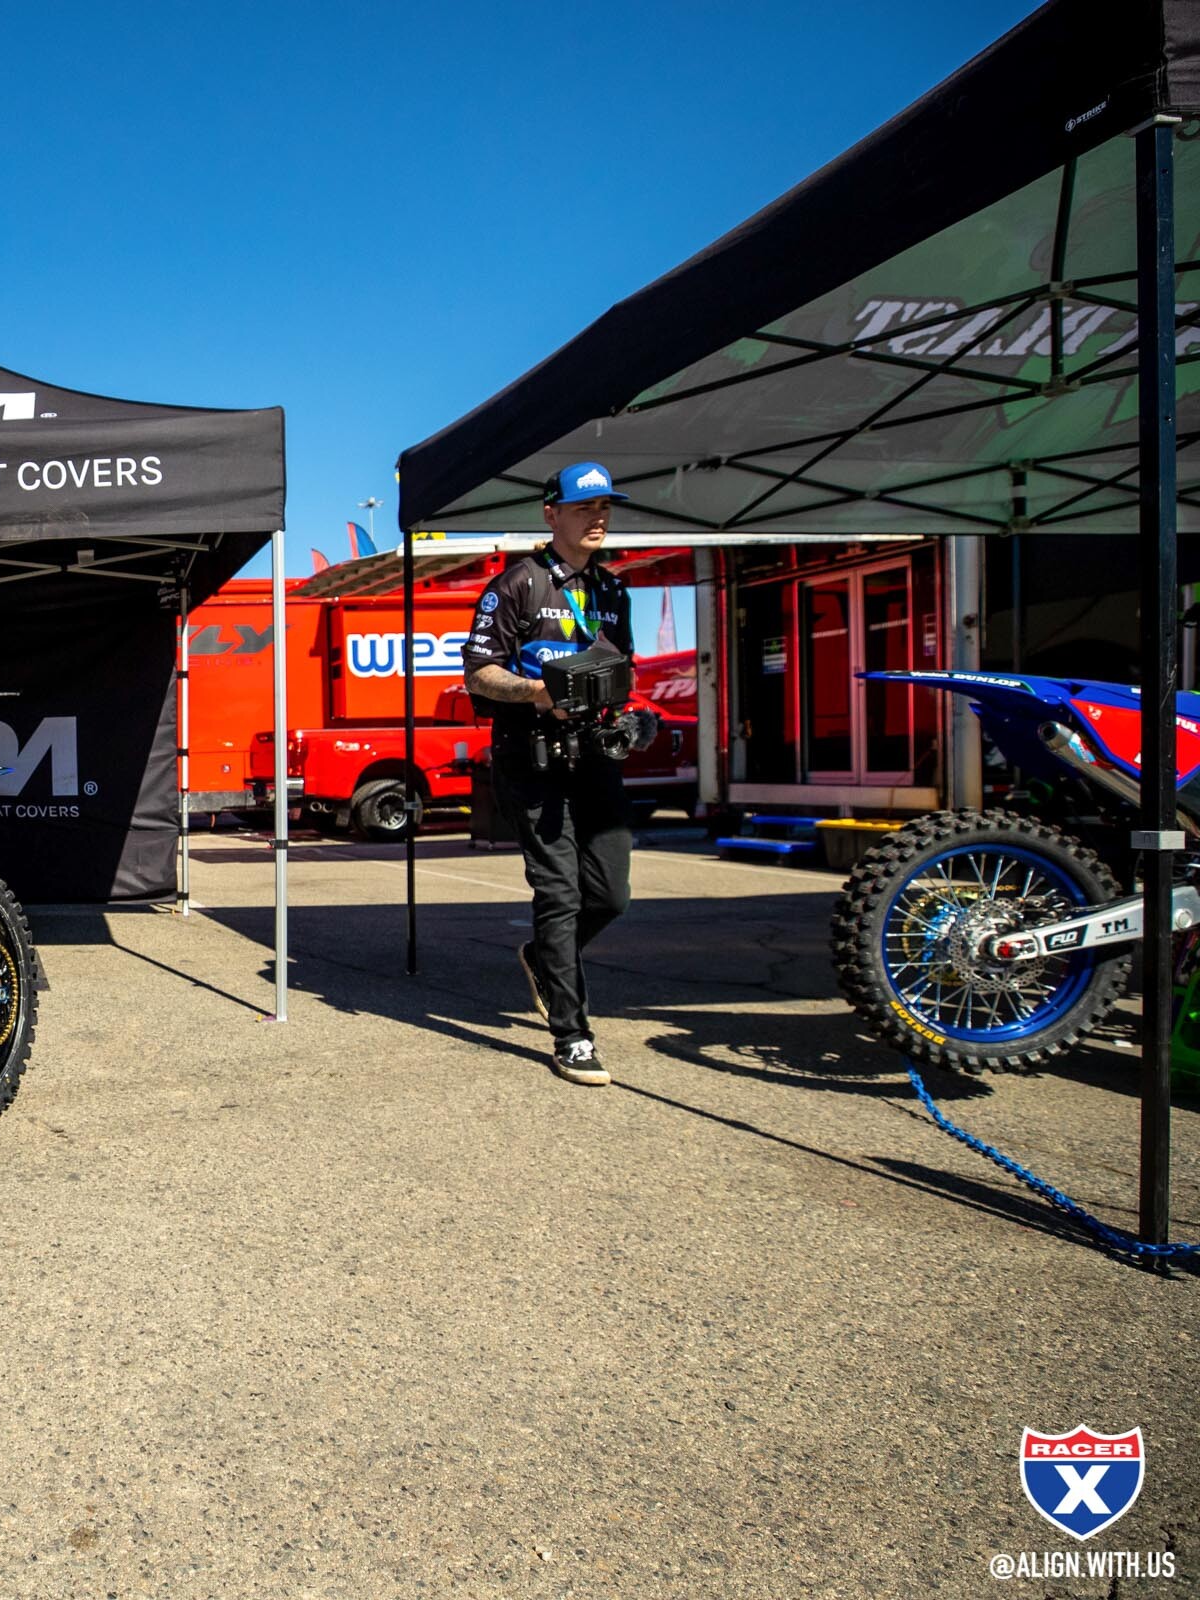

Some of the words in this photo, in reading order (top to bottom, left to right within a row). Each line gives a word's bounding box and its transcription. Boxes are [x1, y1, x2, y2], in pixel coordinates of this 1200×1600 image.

[17, 456, 163, 492] COVERS
[953, 674, 1021, 687] DUNLOP
[16, 804, 80, 818] COVERS
[1102, 918, 1130, 934] TM
[1050, 934, 1077, 946] FLO
[890, 1000, 946, 1046] DUNLOP
